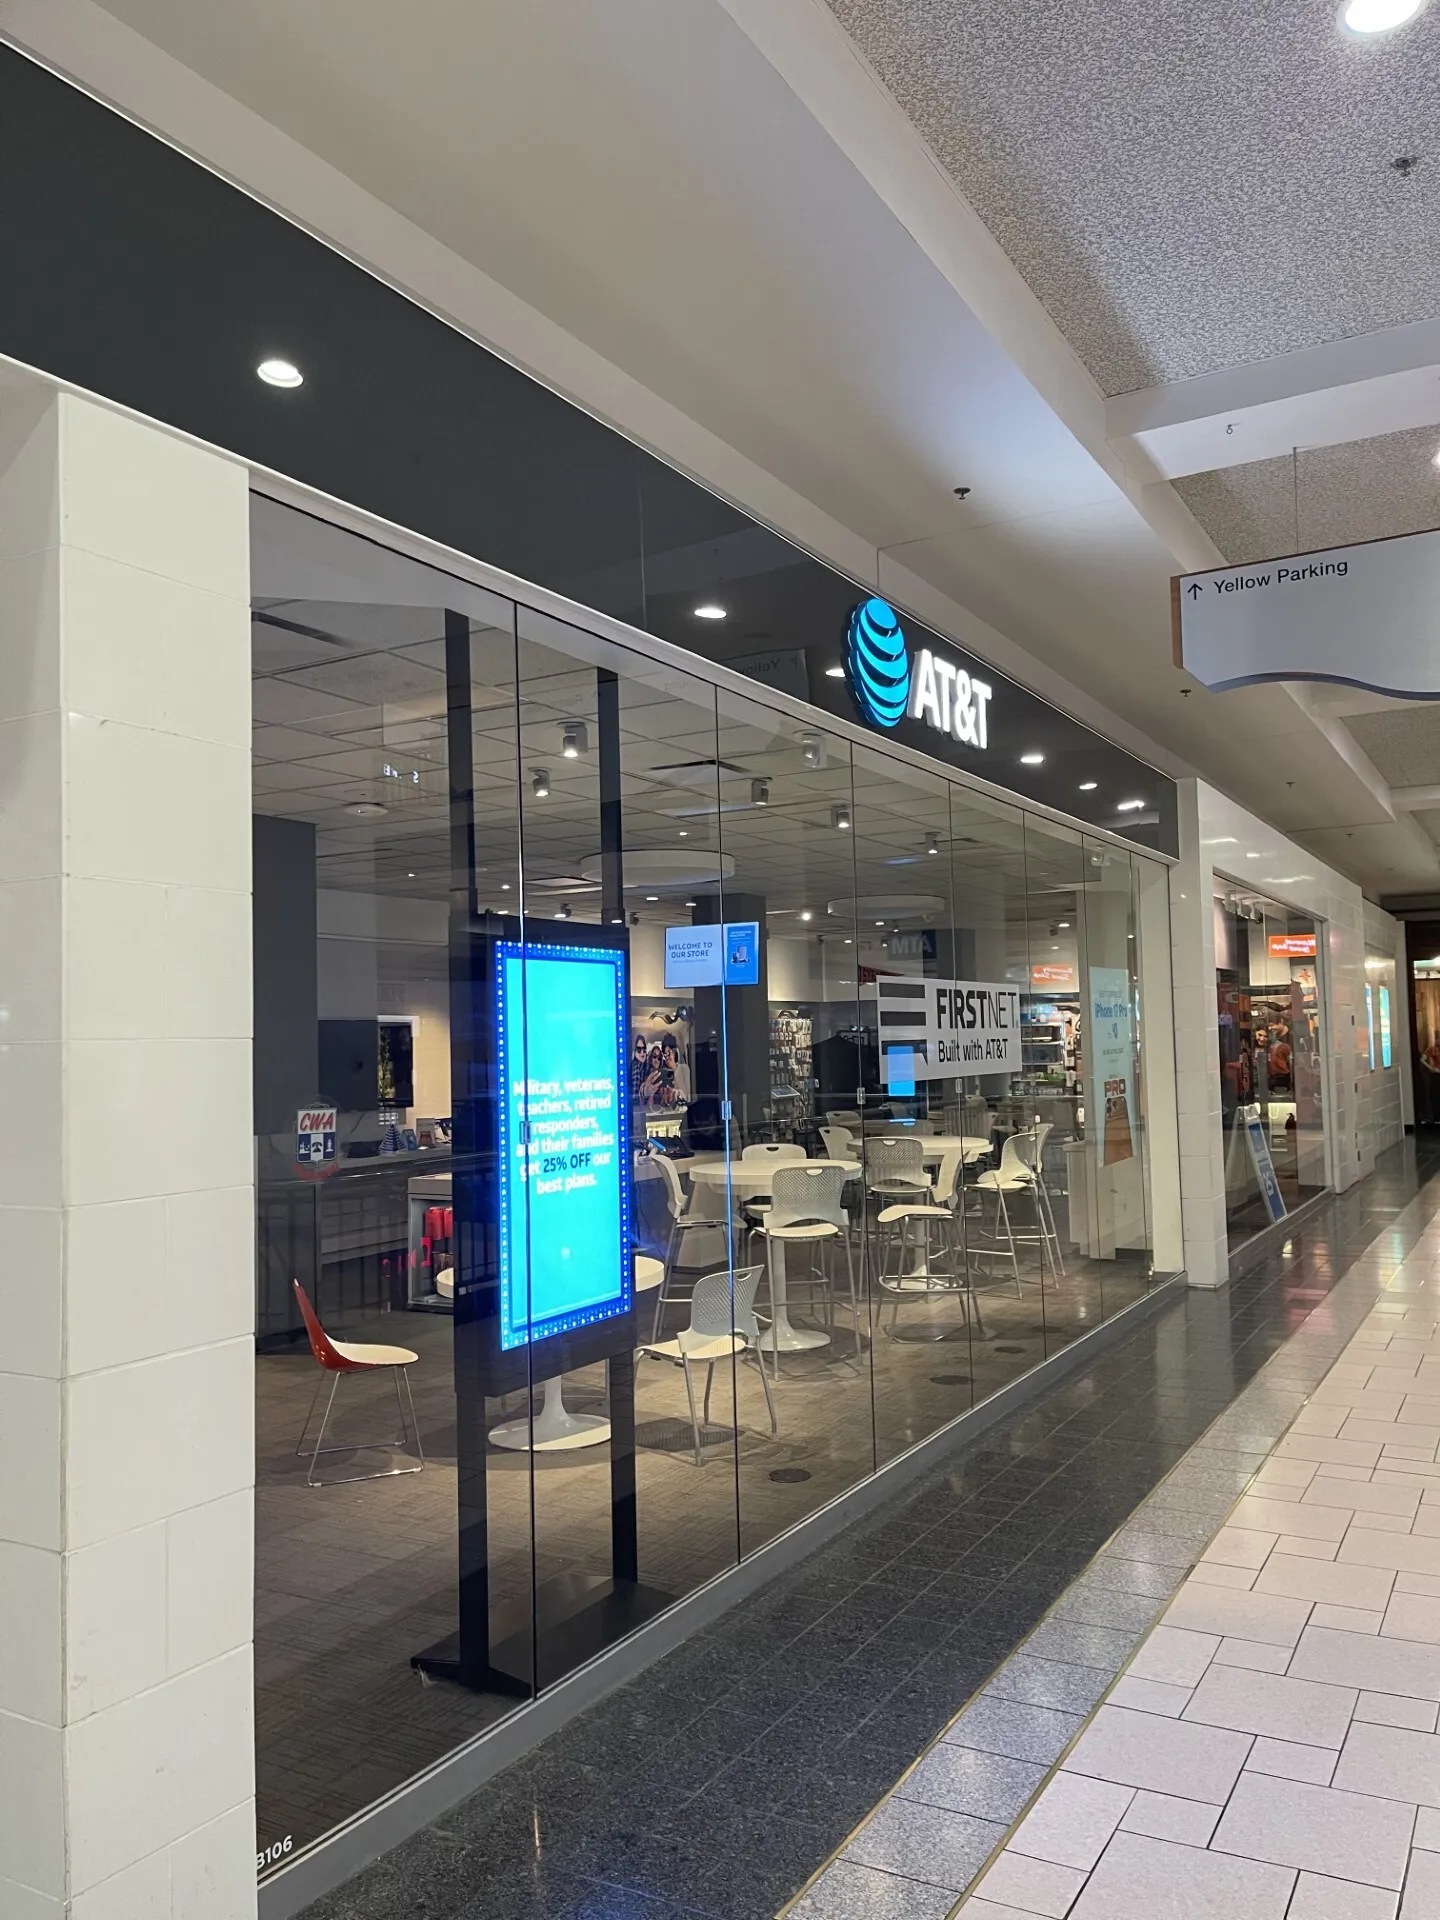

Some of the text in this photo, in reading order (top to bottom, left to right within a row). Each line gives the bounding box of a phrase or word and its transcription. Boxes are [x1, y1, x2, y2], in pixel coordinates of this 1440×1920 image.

[1214, 561, 1348, 594] Yellow Parking
[908, 649, 992, 749] AT&T
[668, 941, 713, 951] WELCOME TO
[671, 949, 709, 959] OUR STORE
[938, 1038, 1008, 1063] Built with AT&T
[513, 1079, 562, 1098] Mlitary,
[574, 1093, 611, 1110] retired
[300, 1112, 334, 1131] CWA
[541, 1136, 568, 1154] their
[571, 1131, 614, 1149] families
[543, 1157, 567, 1173] 25%
[570, 1153, 591, 1169] OFF
[593, 1152, 611, 1166] our
[536, 1178, 563, 1194] best
